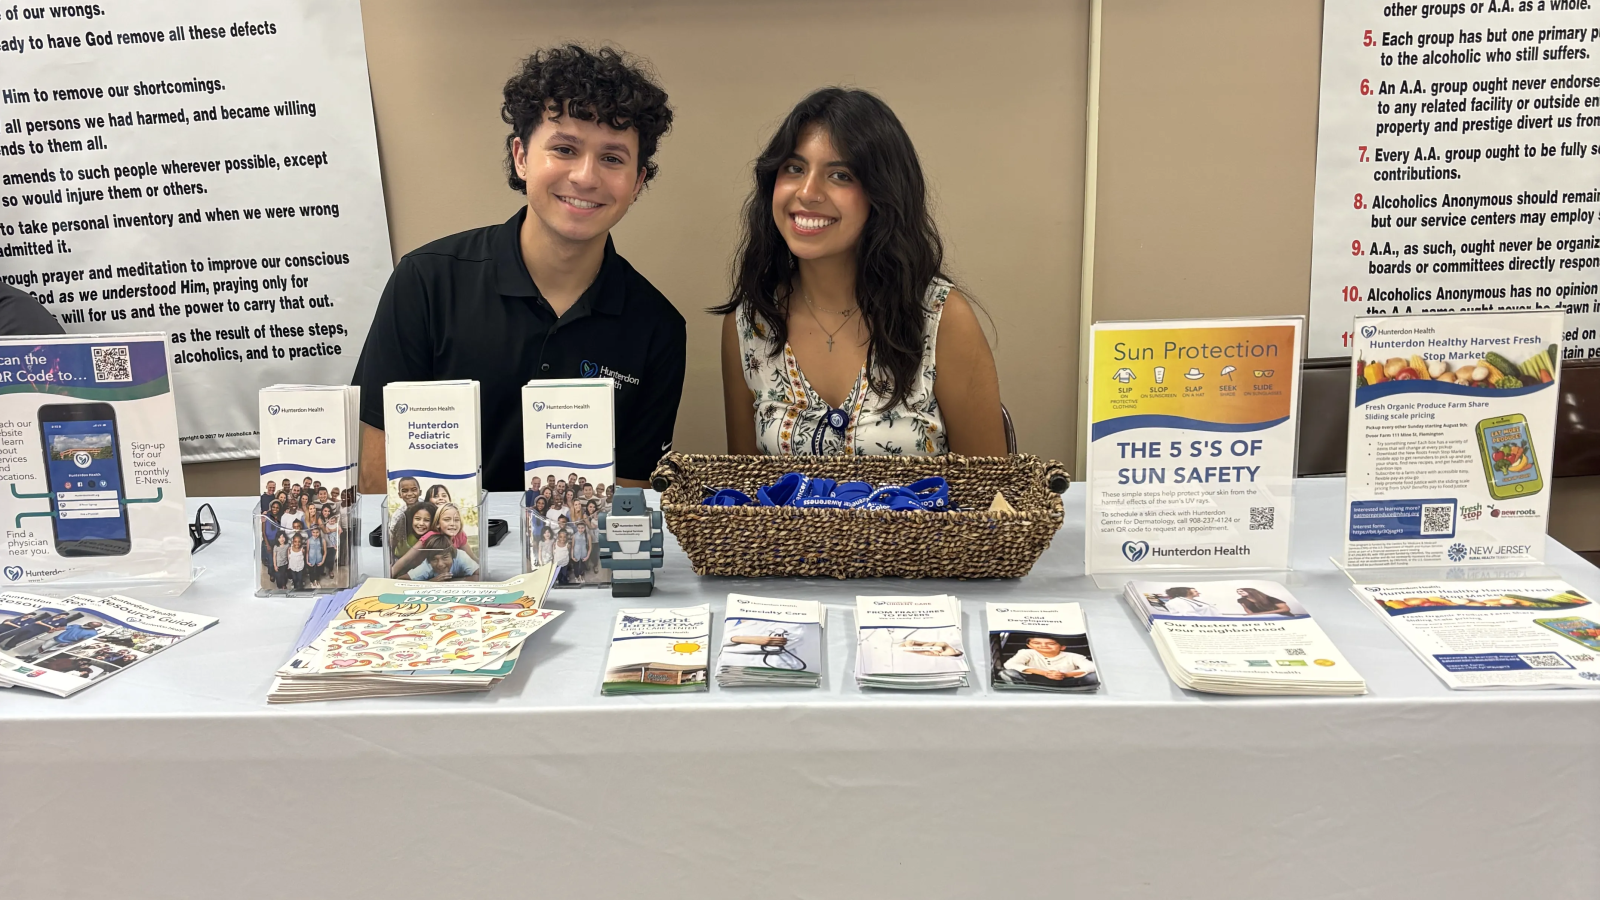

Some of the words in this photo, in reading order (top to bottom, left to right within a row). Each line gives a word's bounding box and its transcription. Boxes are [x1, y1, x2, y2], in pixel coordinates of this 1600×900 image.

[1363, 30, 1376, 47] 5.
[1382, 32, 1413, 46] Each
[1418, 34, 1454, 48] group
[1459, 30, 1482, 43] has
[1487, 28, 1507, 42] but
[1512, 30, 1534, 41] one
[1538, 26, 1587, 41] primary
[1381, 53, 1393, 66] to
[1398, 51, 1418, 65] the
[1423, 49, 1481, 64] alcoholic
[1486, 48, 1511, 62] who
[1516, 46, 1538, 61] still
[1543, 45, 1589, 60] suffers.
[2, 89, 30, 104] Him
[34, 88, 48, 102] to
[53, 88, 103, 100] remove
[108, 86, 129, 97] our
[134, 78, 225, 96] shortcomings.
[5, 119, 22, 133] all
[26, 119, 80, 135] persons
[85, 117, 104, 128] we
[108, 112, 133, 127] had
[136, 108, 189, 125] harmed,
[193, 106, 217, 121] and
[221, 106, 270, 119] became
[274, 100, 316, 117] willing
[1359, 146, 1369, 162] 7.
[1375, 148, 1409, 164] Every
[1414, 147, 1440, 161] A.A.
[1446, 146, 1481, 163] group
[1486, 144, 1520, 161] ought
[1524, 144, 1536, 157] to
[1541, 143, 1556, 156] be
[1561, 142, 1587, 158] fully
[1342, 286, 1362, 302] 10.
[1367, 287, 1431, 301] Alcoholics
[1436, 287, 1506, 302] Anonymous
[1510, 284, 1531, 297] has
[1536, 287, 1551, 296] no
[1556, 282, 1598, 299] opinion
[172, 333, 186, 343] as
[190, 328, 211, 342] the
[216, 326, 250, 340] result
[254, 325, 265, 338] of
[270, 324, 304, 337] these
[309, 323, 347, 338] steps,
[1370, 339, 1424, 348] Hunterdon
[1428, 338, 1468, 348] Healthy
[1514, 336, 1541, 344] Fresh
[174, 347, 242, 364] alcoholics,
[246, 346, 268, 359] and
[272, 346, 284, 358] to
[289, 342, 341, 360] practice
[1114, 343, 1153, 360] Sun
[1165, 340, 1278, 359] Protection
[0, 356, 20, 365] can
[24, 353, 46, 364] the
[1423, 353, 1445, 362] Stop
[1449, 352, 1486, 360] Market
[16, 369, 53, 382] Code
[600, 366, 639, 385] Hunterdon
[1387, 403, 1415, 411] Organic
[1410, 412, 1435, 420] pricing
[408, 421, 458, 429] Hunterdon
[409, 431, 450, 439] Pediatric
[546, 432, 572, 440] Family
[278, 437, 312, 446] Primary
[315, 436, 336, 444] Care
[132, 442, 165, 451] Sign-up
[1117, 442, 1161, 458] THE
[1170, 442, 1181, 457] 5
[1190, 440, 1222, 457] S'S
[1230, 440, 1262, 456] OF
[0, 473, 37, 481] ocations.
[135, 468, 169, 477] monthly
[1118, 468, 1165, 484] SUN
[1174, 466, 1260, 483] SAFETY
[1134, 517, 1175, 525] Dermatology,
[1463, 511, 1482, 521] stop
[8, 538, 48, 548] physician
[32, 548, 49, 557] you.
[1152, 546, 1211, 556] Hunterdon
[1214, 545, 1250, 555] Health
[1470, 546, 1494, 555] NEW
[1496, 545, 1531, 554] JERSEY
[26, 569, 65, 577] Hunterd
[405, 595, 496, 603] DOCTOR
[98, 598, 156, 620] Resource
[158, 615, 197, 627] Guide
[739, 608, 782, 616] Specialty
